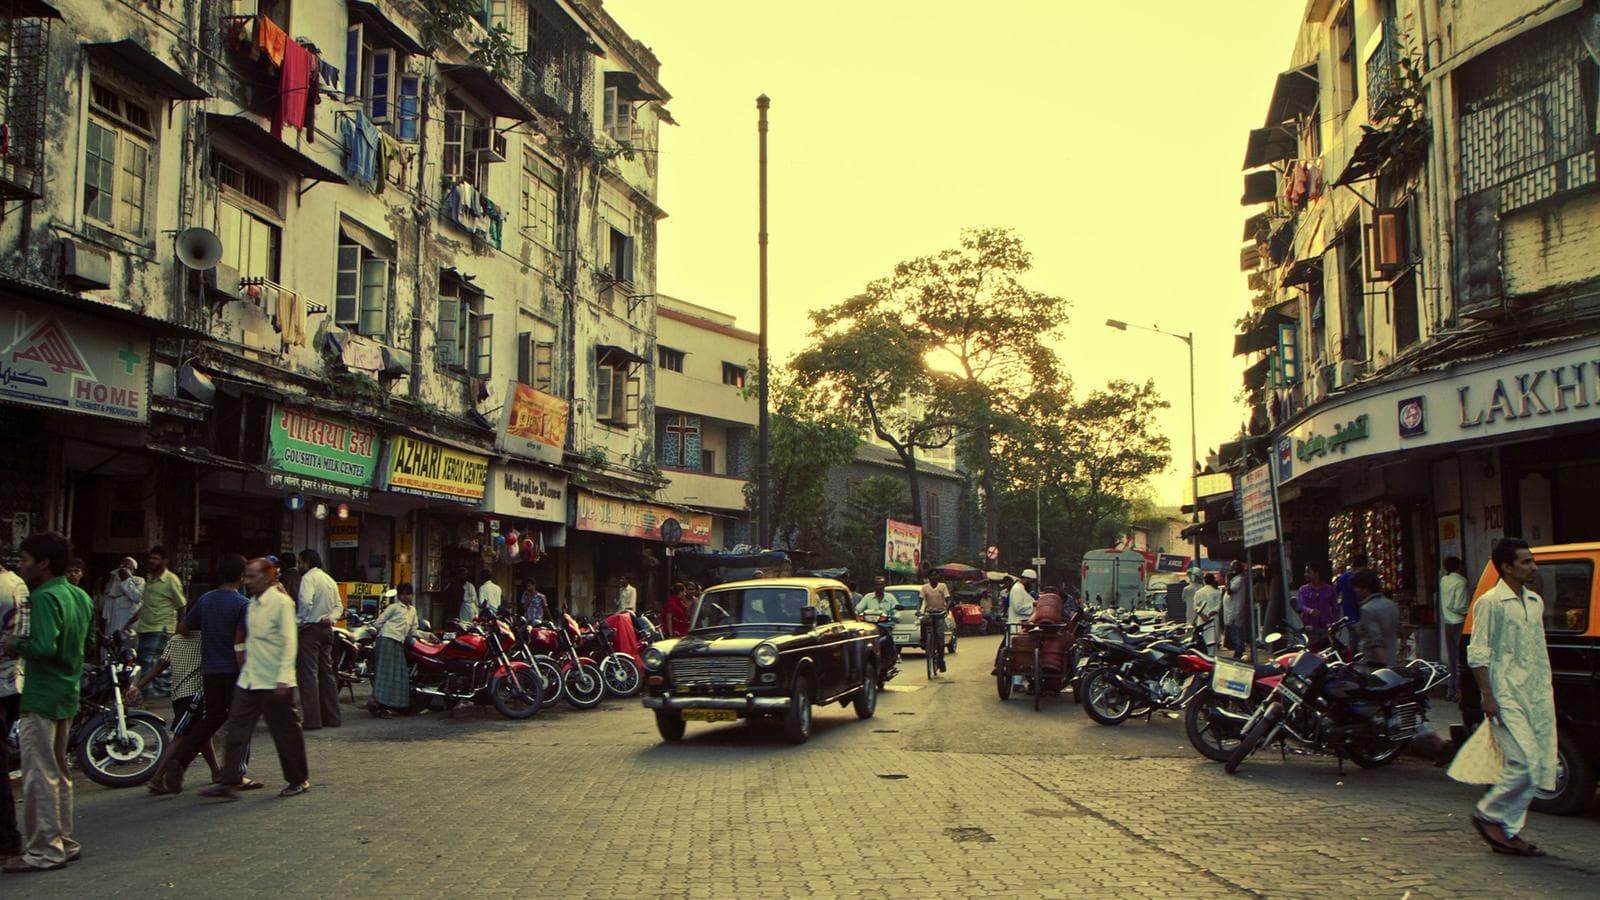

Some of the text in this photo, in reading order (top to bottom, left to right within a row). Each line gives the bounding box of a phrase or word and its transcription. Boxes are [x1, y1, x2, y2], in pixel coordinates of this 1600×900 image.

[75, 400, 101, 411] CHEMIST
[105, 405, 138, 418] PROVISIONS
[76, 380, 139, 409] HOME
[284, 448, 365, 478] GOUSHIYA MILK CENTER
[394, 438, 488, 487] AZHARI XEROX CENTRE
[504, 473, 540, 498] Majestic
